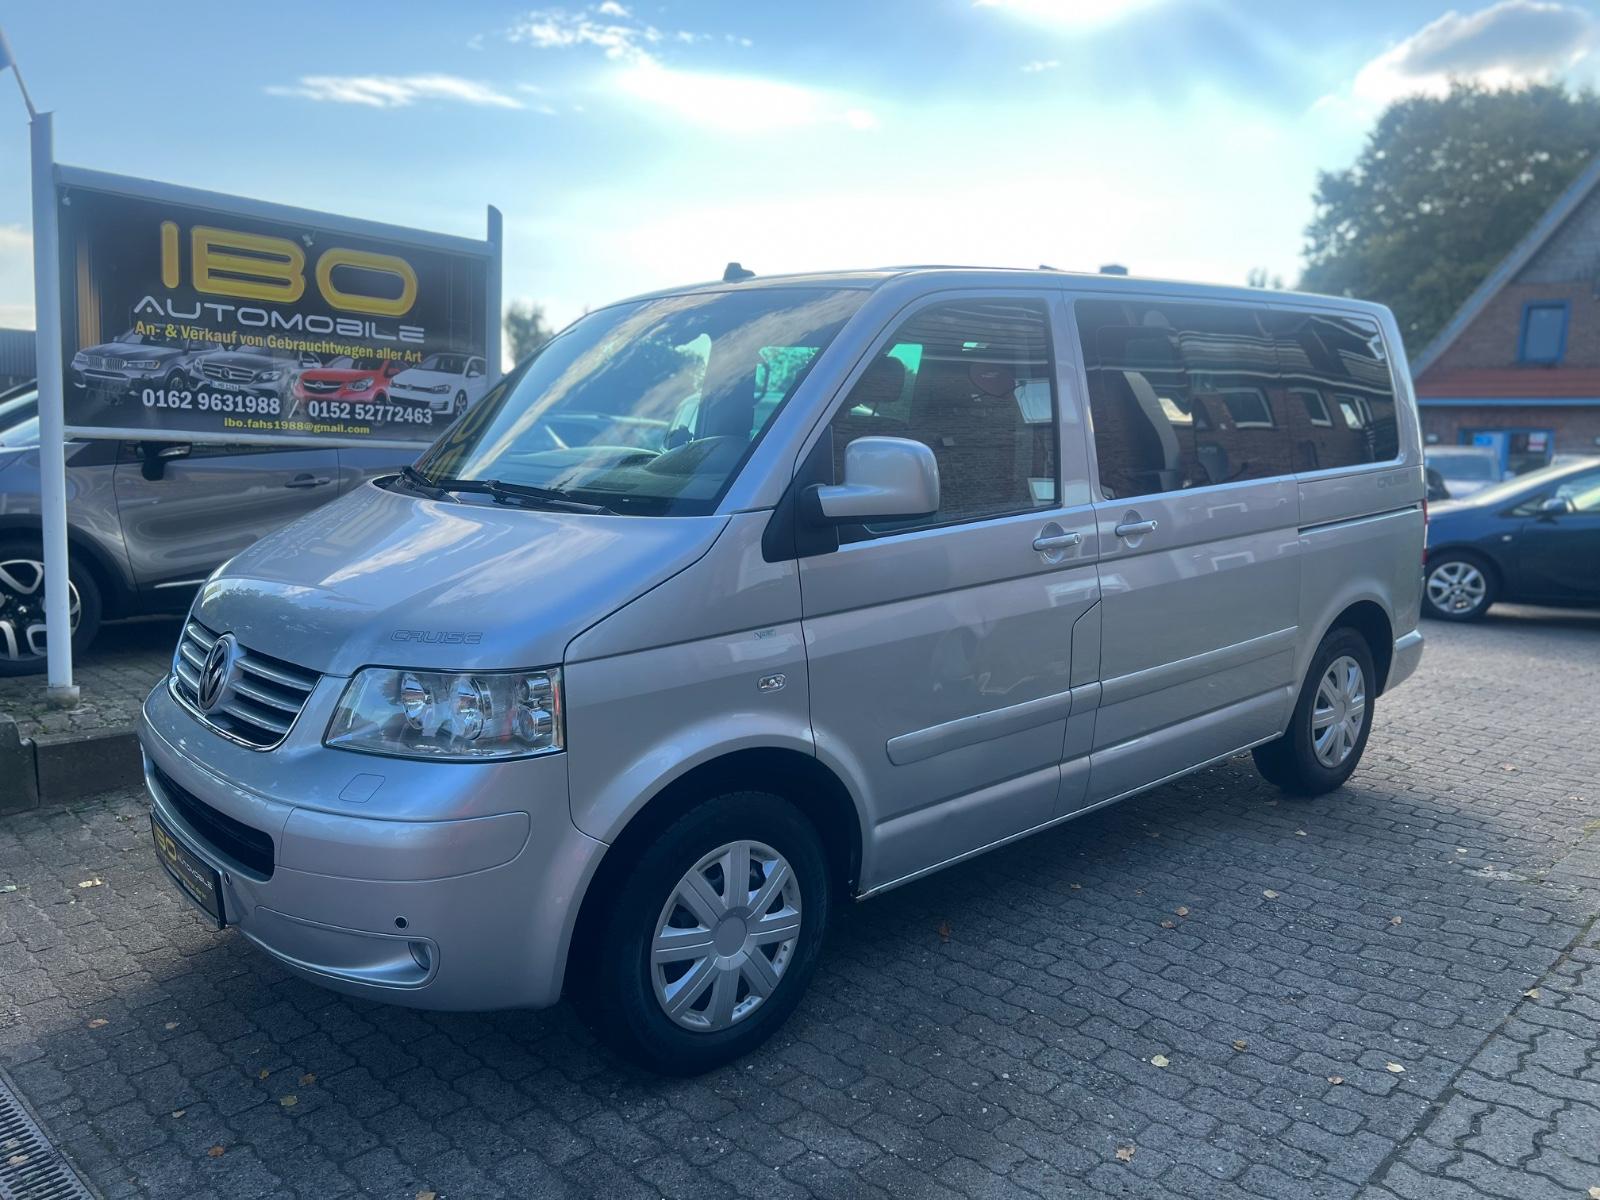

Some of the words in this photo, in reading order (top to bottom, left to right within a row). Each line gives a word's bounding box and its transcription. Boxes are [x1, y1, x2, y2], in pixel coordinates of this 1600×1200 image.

[160, 219, 419, 319] IBO
[133, 295, 425, 344] AUTOMOBILE
[134, 321, 161, 336] An-
[164, 323, 178, 339] &
[180, 325, 238, 345] Verkauf
[240, 334, 264, 347] von
[266, 334, 374, 360] Gebrauchtwagen
[376, 347, 402, 361] aller
[404, 350, 422, 363] Art
[142, 388, 193, 409] 0162
[197, 392, 281, 415] 9631988
[308, 400, 350, 419] 0152
[354, 403, 433, 424] 52772463
[223, 417, 370, 434] ibo.fahs1988@gmail.com
[391, 629, 484, 645] CRUISE
